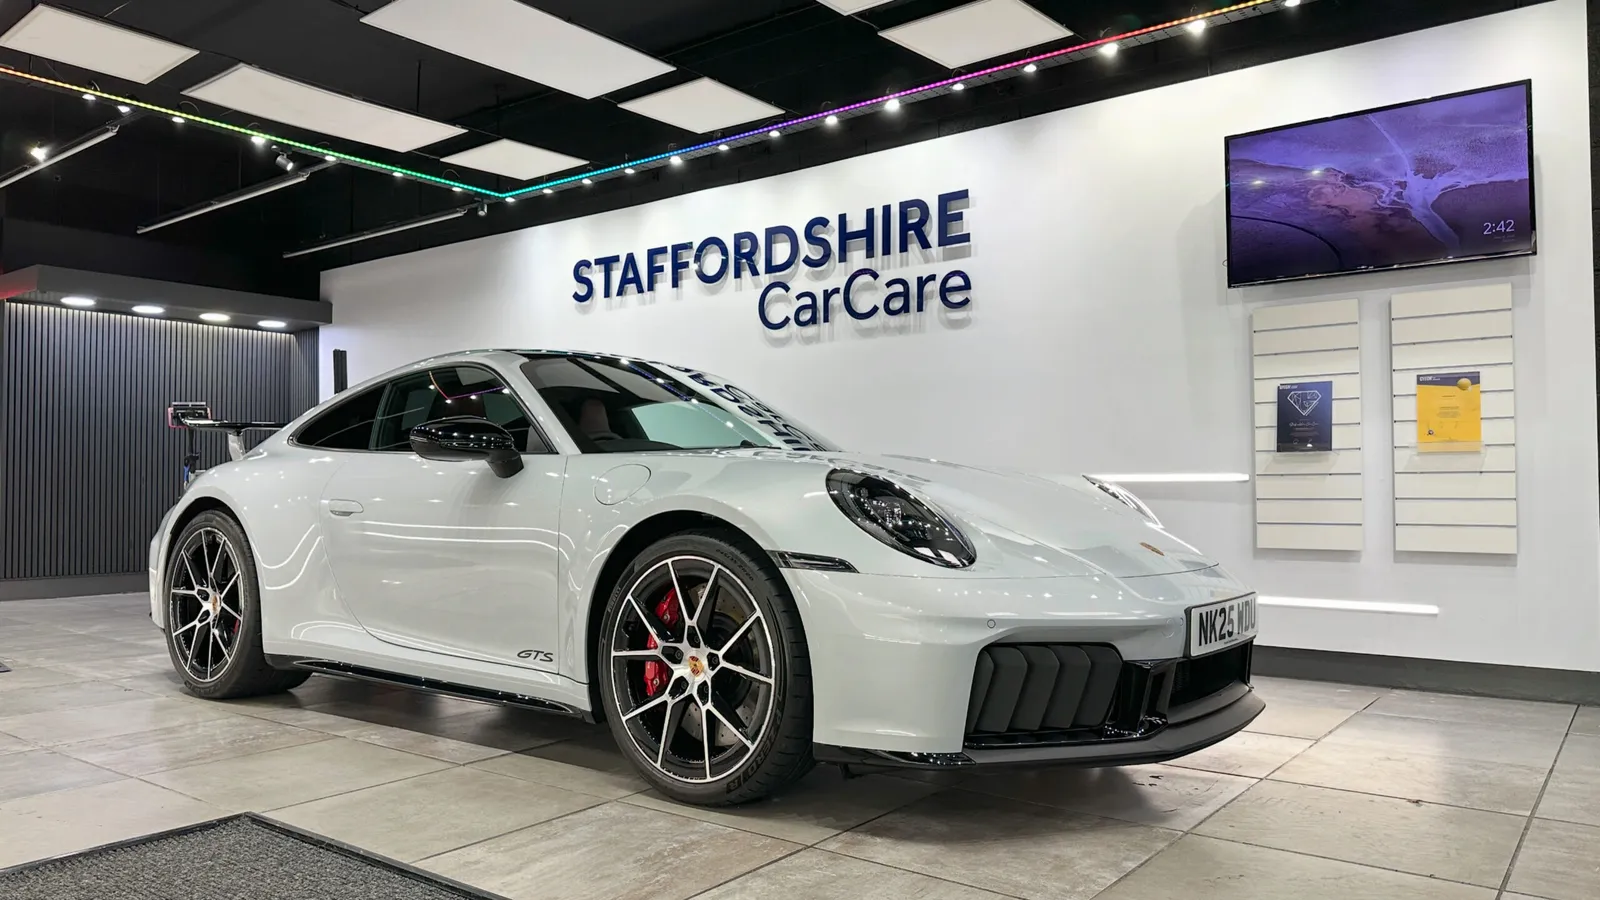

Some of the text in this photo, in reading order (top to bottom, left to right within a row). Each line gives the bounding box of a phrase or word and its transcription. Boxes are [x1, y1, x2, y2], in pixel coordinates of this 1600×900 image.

[572, 188, 971, 304] STAFFORDSHIRE
[1483, 219, 1515, 235] 2:42
[758, 269, 972, 330] CarCare
[1198, 606, 1235, 647] NK25
[517, 649, 554, 662] GTS
